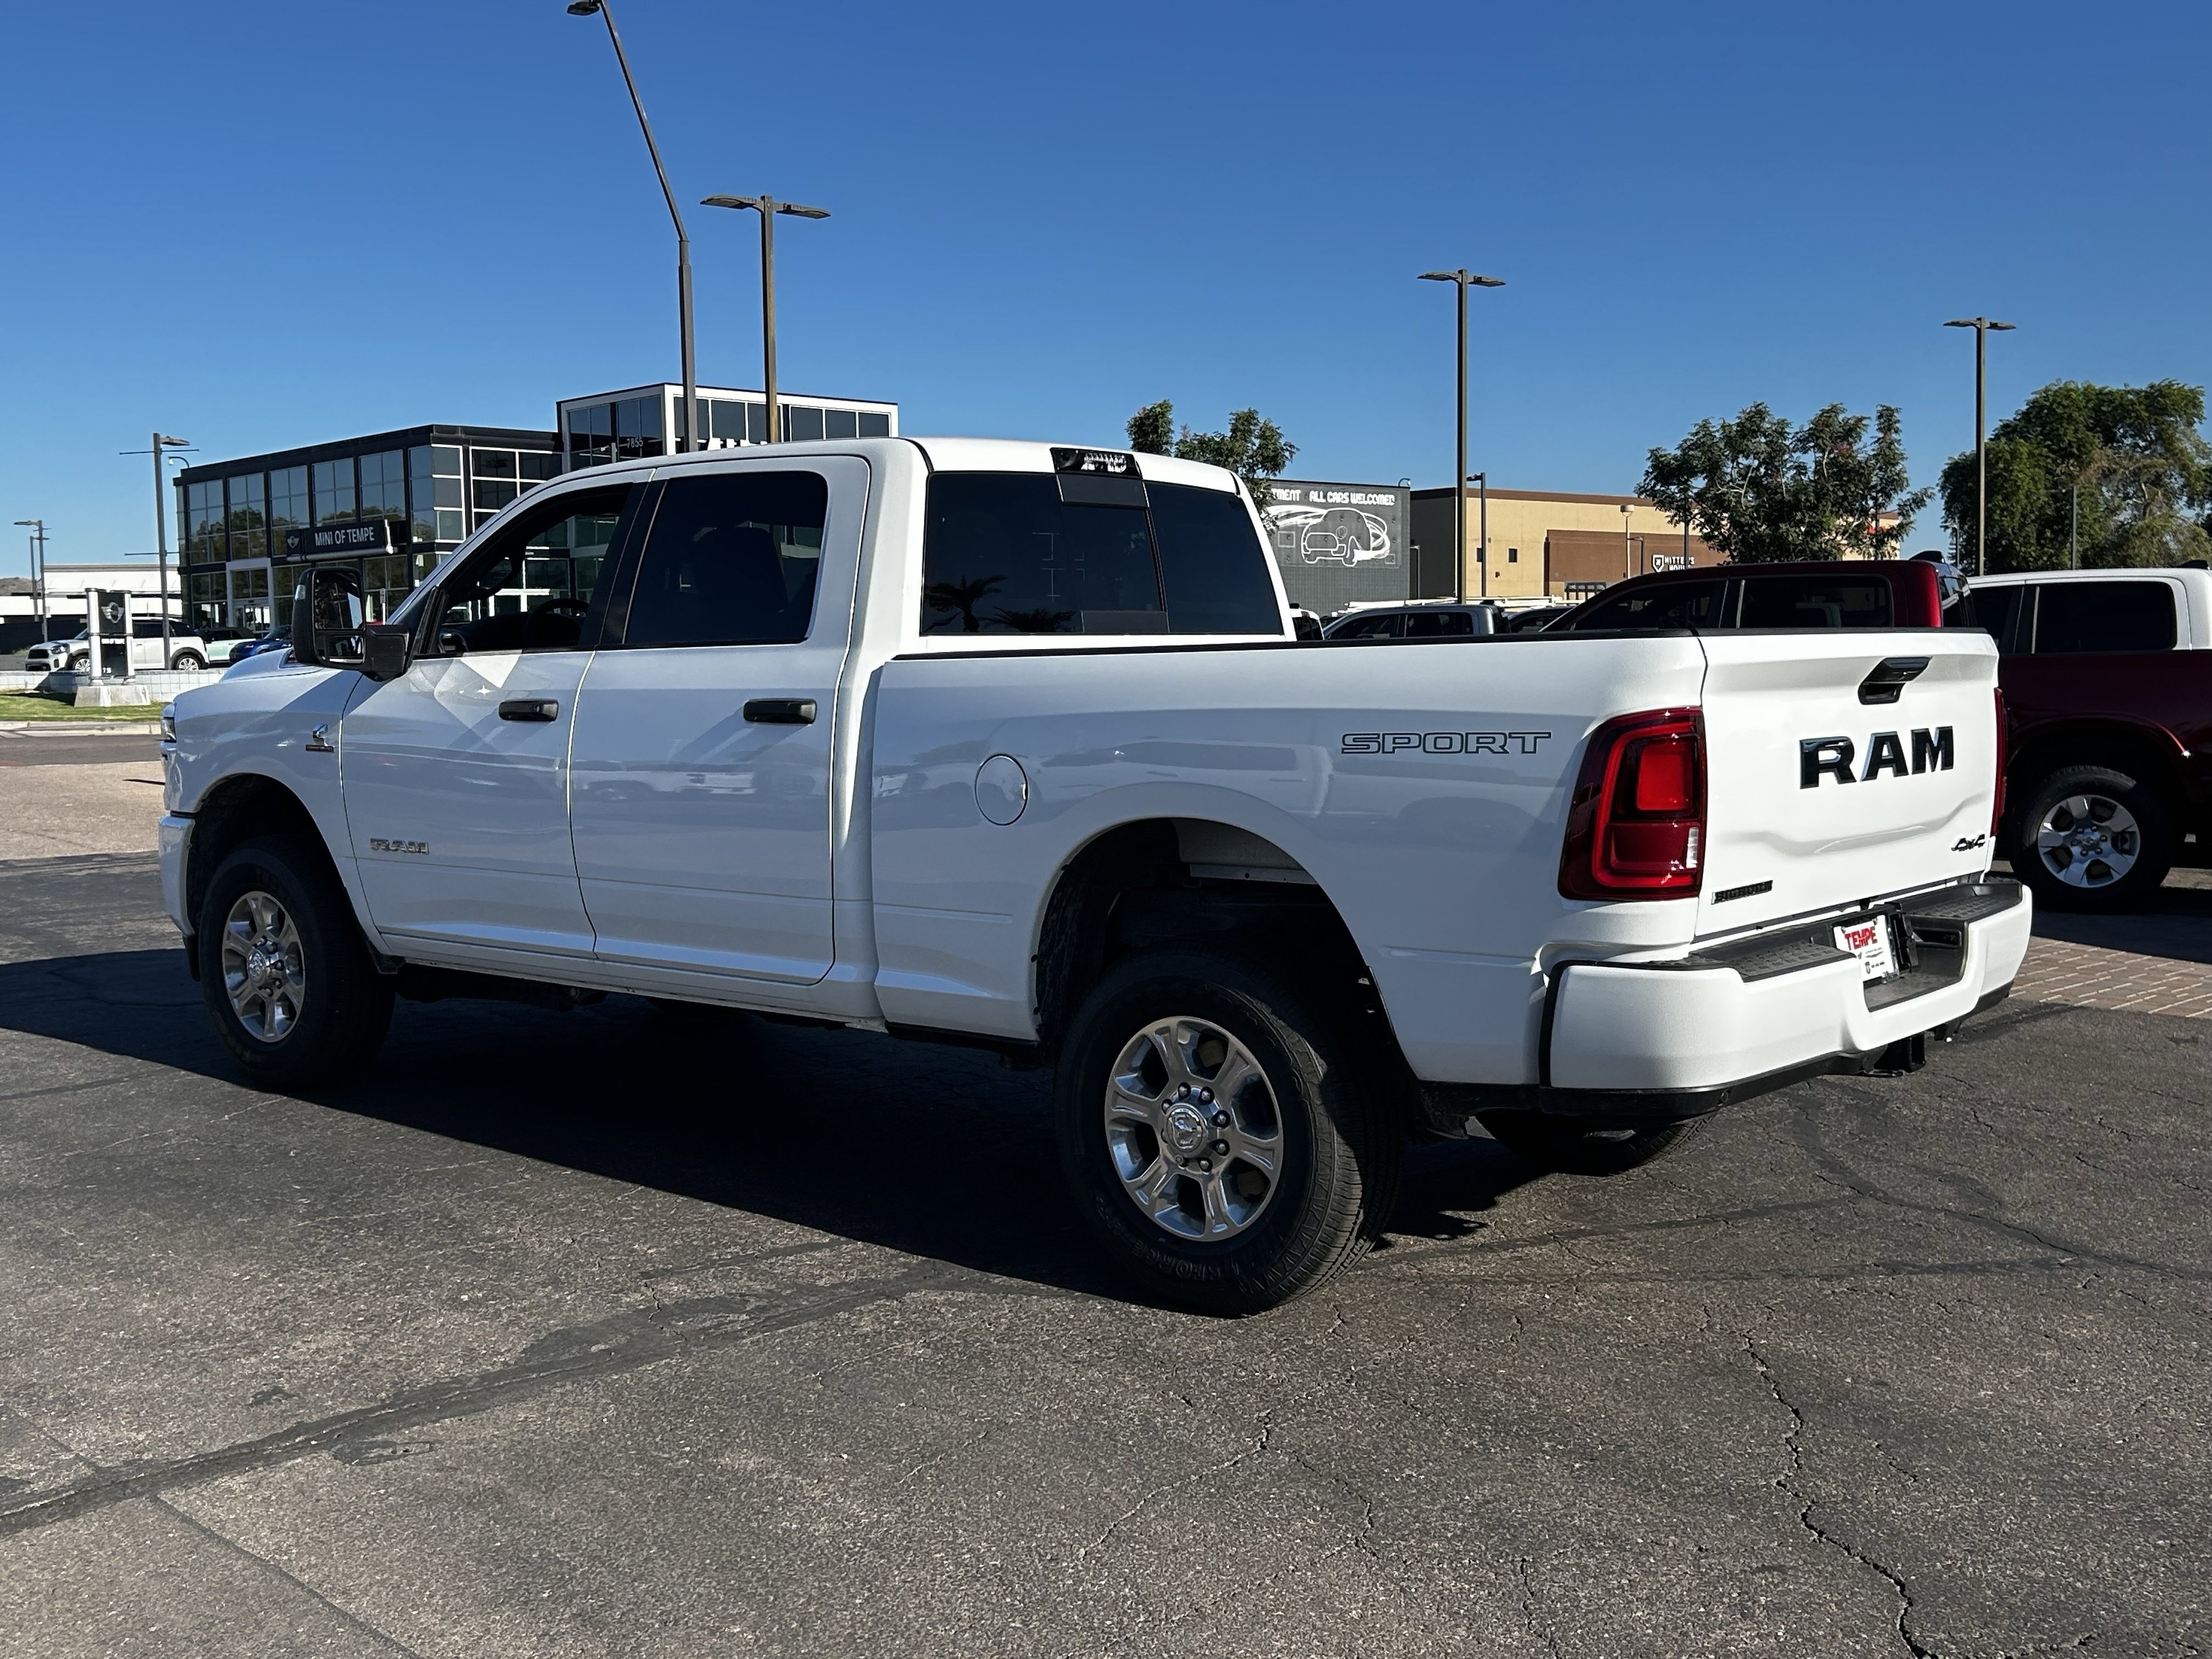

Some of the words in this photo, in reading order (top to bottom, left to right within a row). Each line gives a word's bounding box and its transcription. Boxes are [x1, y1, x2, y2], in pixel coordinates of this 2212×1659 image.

[1309, 490, 1326, 503] ALL
[1327, 492, 1349, 504] CARS
[314, 532, 333, 546] MINI
[335, 530, 346, 545] OF
[347, 527, 375, 543] TEMPE
[1341, 731, 1552, 754] SPORT
[1799, 725, 1954, 789] RAM
[370, 838, 430, 855] RAM
[1844, 926, 1878, 951] TEMPE
